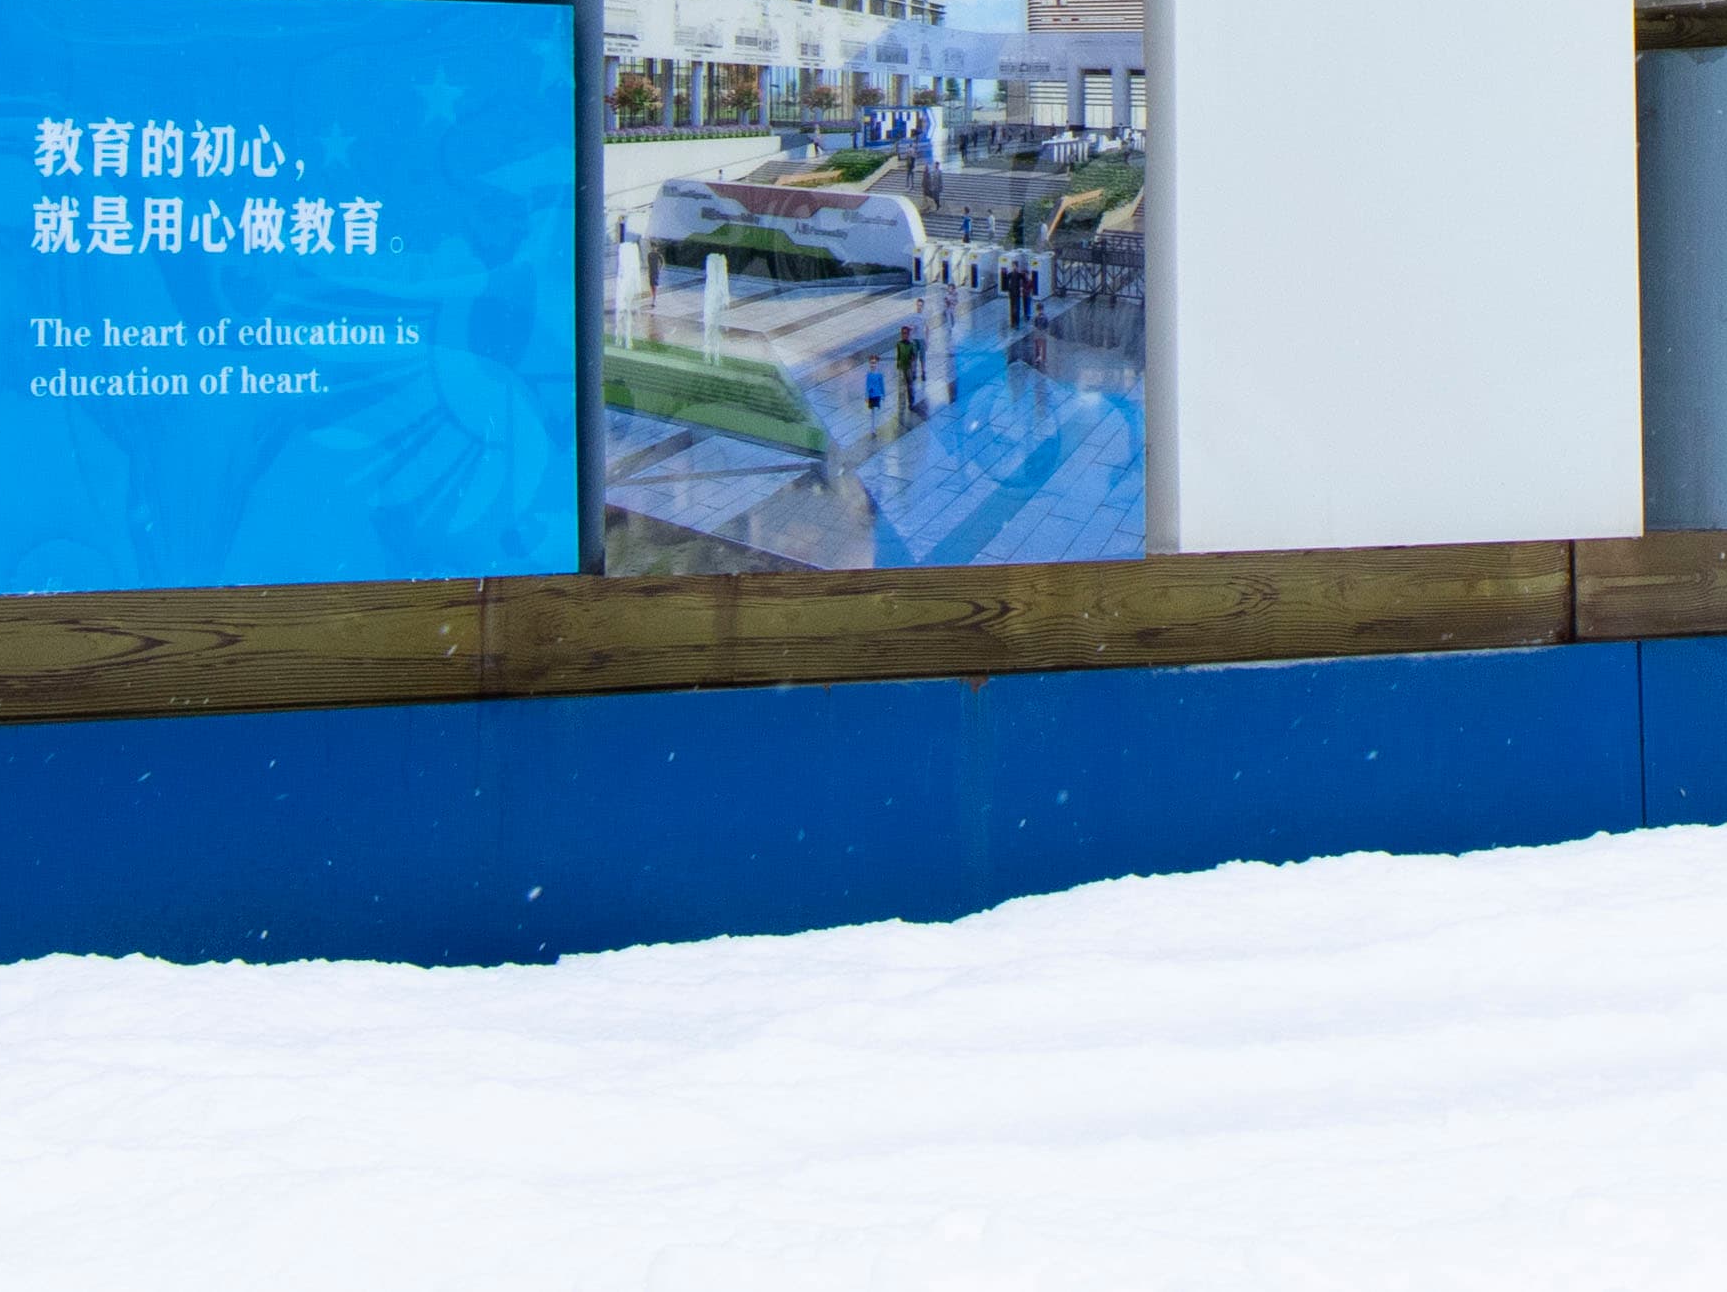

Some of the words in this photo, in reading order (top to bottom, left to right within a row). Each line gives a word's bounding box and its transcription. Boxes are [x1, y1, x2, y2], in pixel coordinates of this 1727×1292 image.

[30, 196, 405, 256] 就是用心做教育。
[30, 317, 91, 349] The
[102, 317, 186, 348] heart
[197, 316, 229, 346] of
[238, 316, 386, 346] education
[394, 316, 420, 346] is
[30, 366, 189, 398] education
[199, 365, 231, 396] of
[239, 365, 330, 396] heart.
